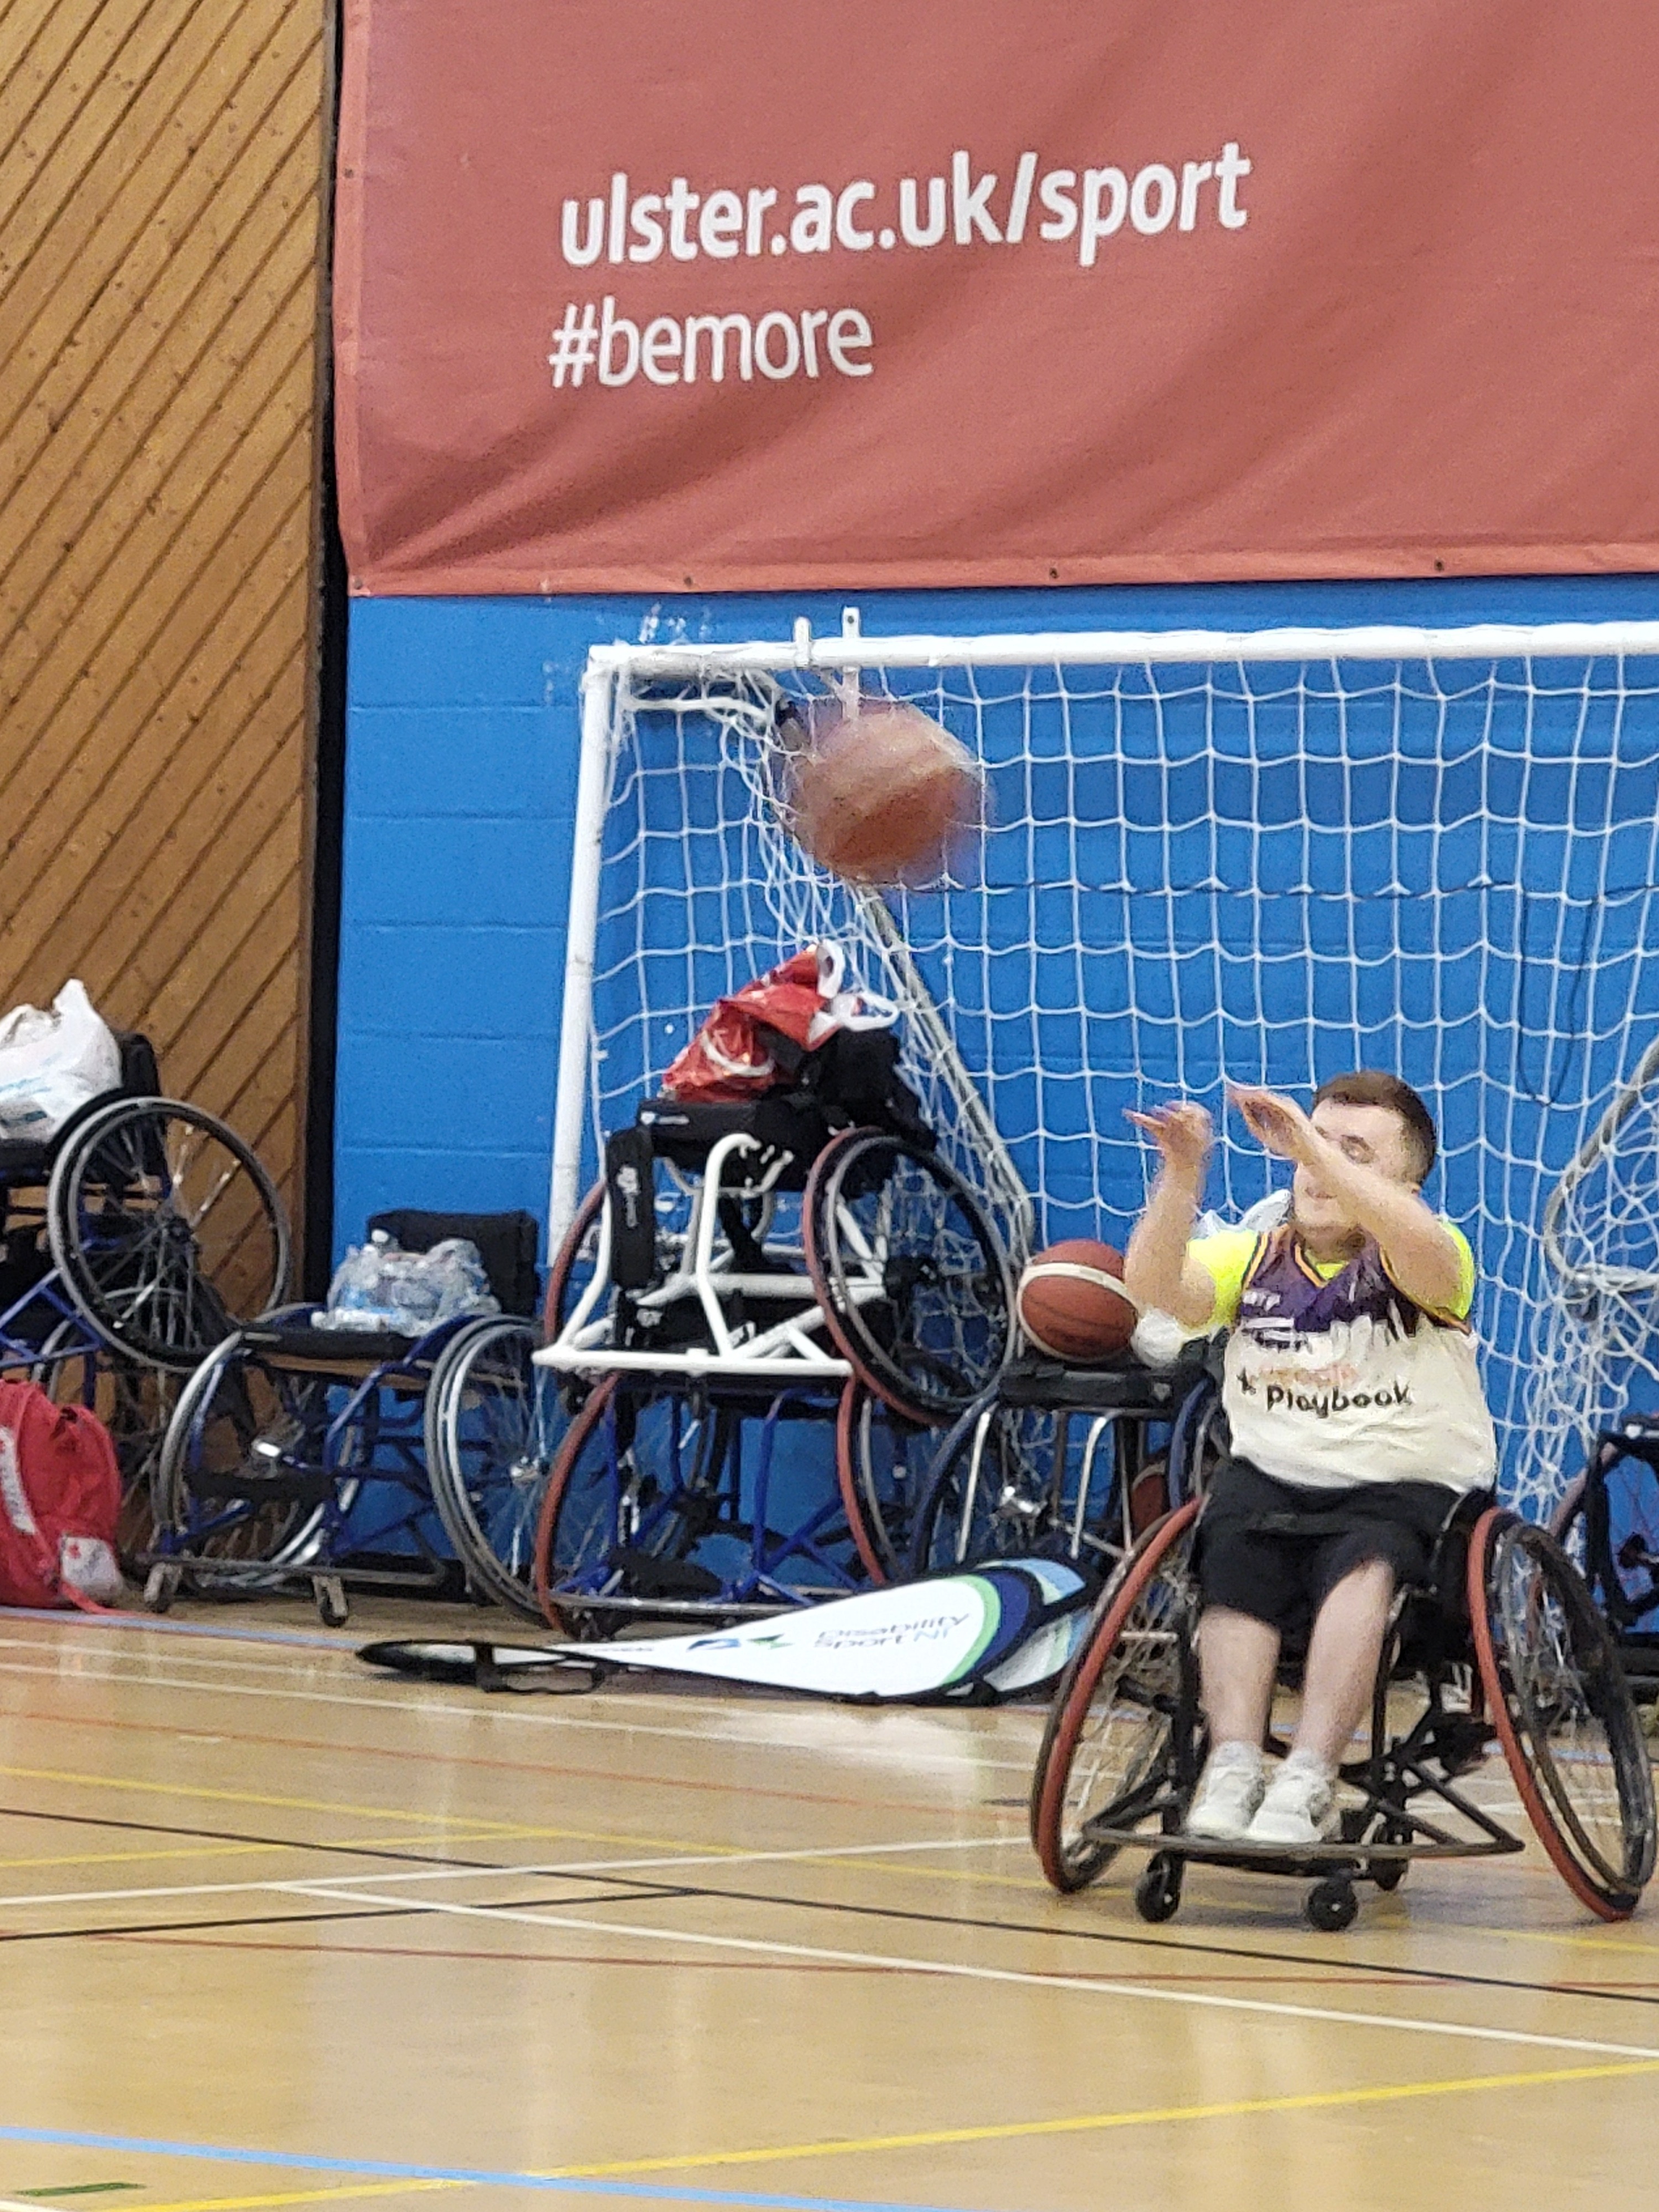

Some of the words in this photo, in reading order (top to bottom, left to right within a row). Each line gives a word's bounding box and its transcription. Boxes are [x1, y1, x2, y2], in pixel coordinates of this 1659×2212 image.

[561, 142, 1251, 268] ulster.ac.uk/sport
[547, 295, 873, 388] #bemore
[1266, 1380, 1413, 1418] Playbook
